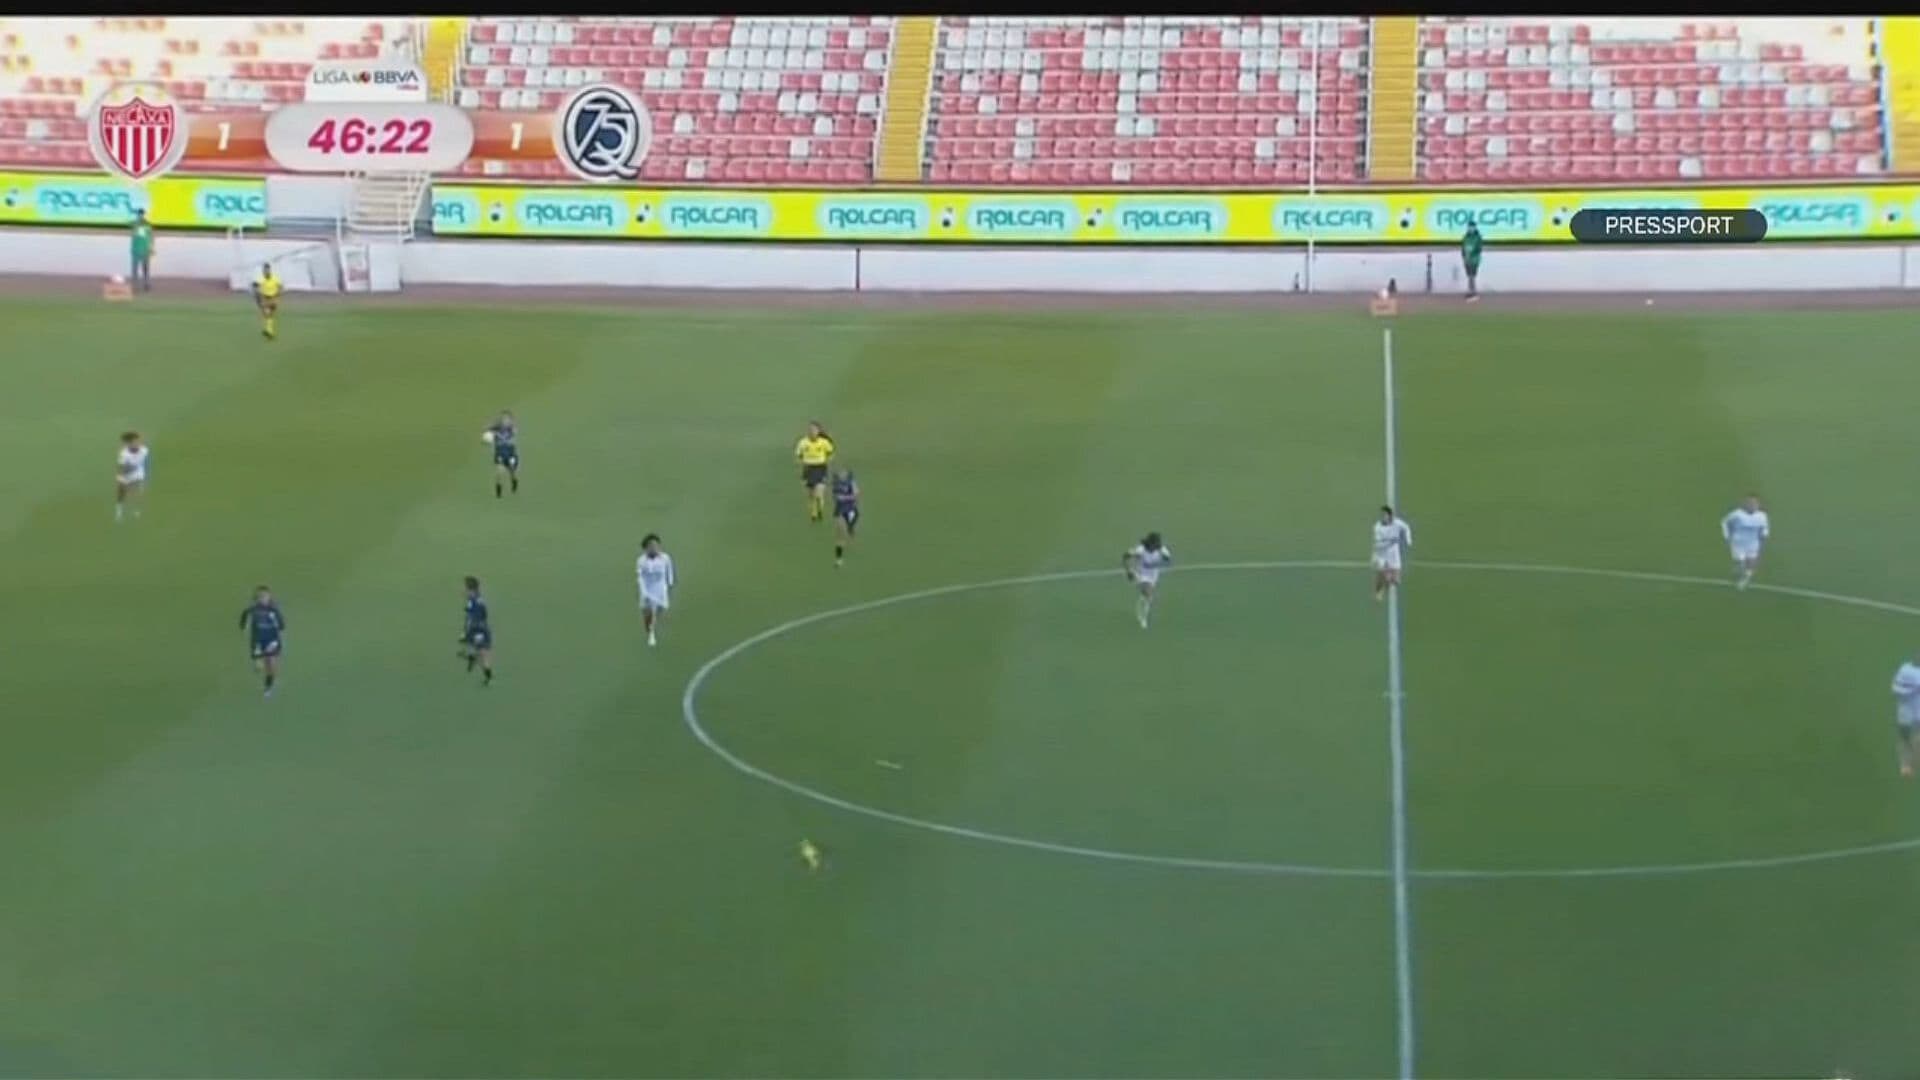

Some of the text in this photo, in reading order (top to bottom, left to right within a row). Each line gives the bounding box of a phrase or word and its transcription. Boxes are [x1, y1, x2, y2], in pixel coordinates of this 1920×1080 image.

[525, 202, 614, 226] ROLCAR
[670, 205, 759, 228] ROLCAR
[828, 207, 916, 228] ROLCAR
[976, 207, 1065, 228] ROLCAR
[1123, 209, 1212, 231] ROLCAR
[1283, 208, 1373, 229] ROLCAR
